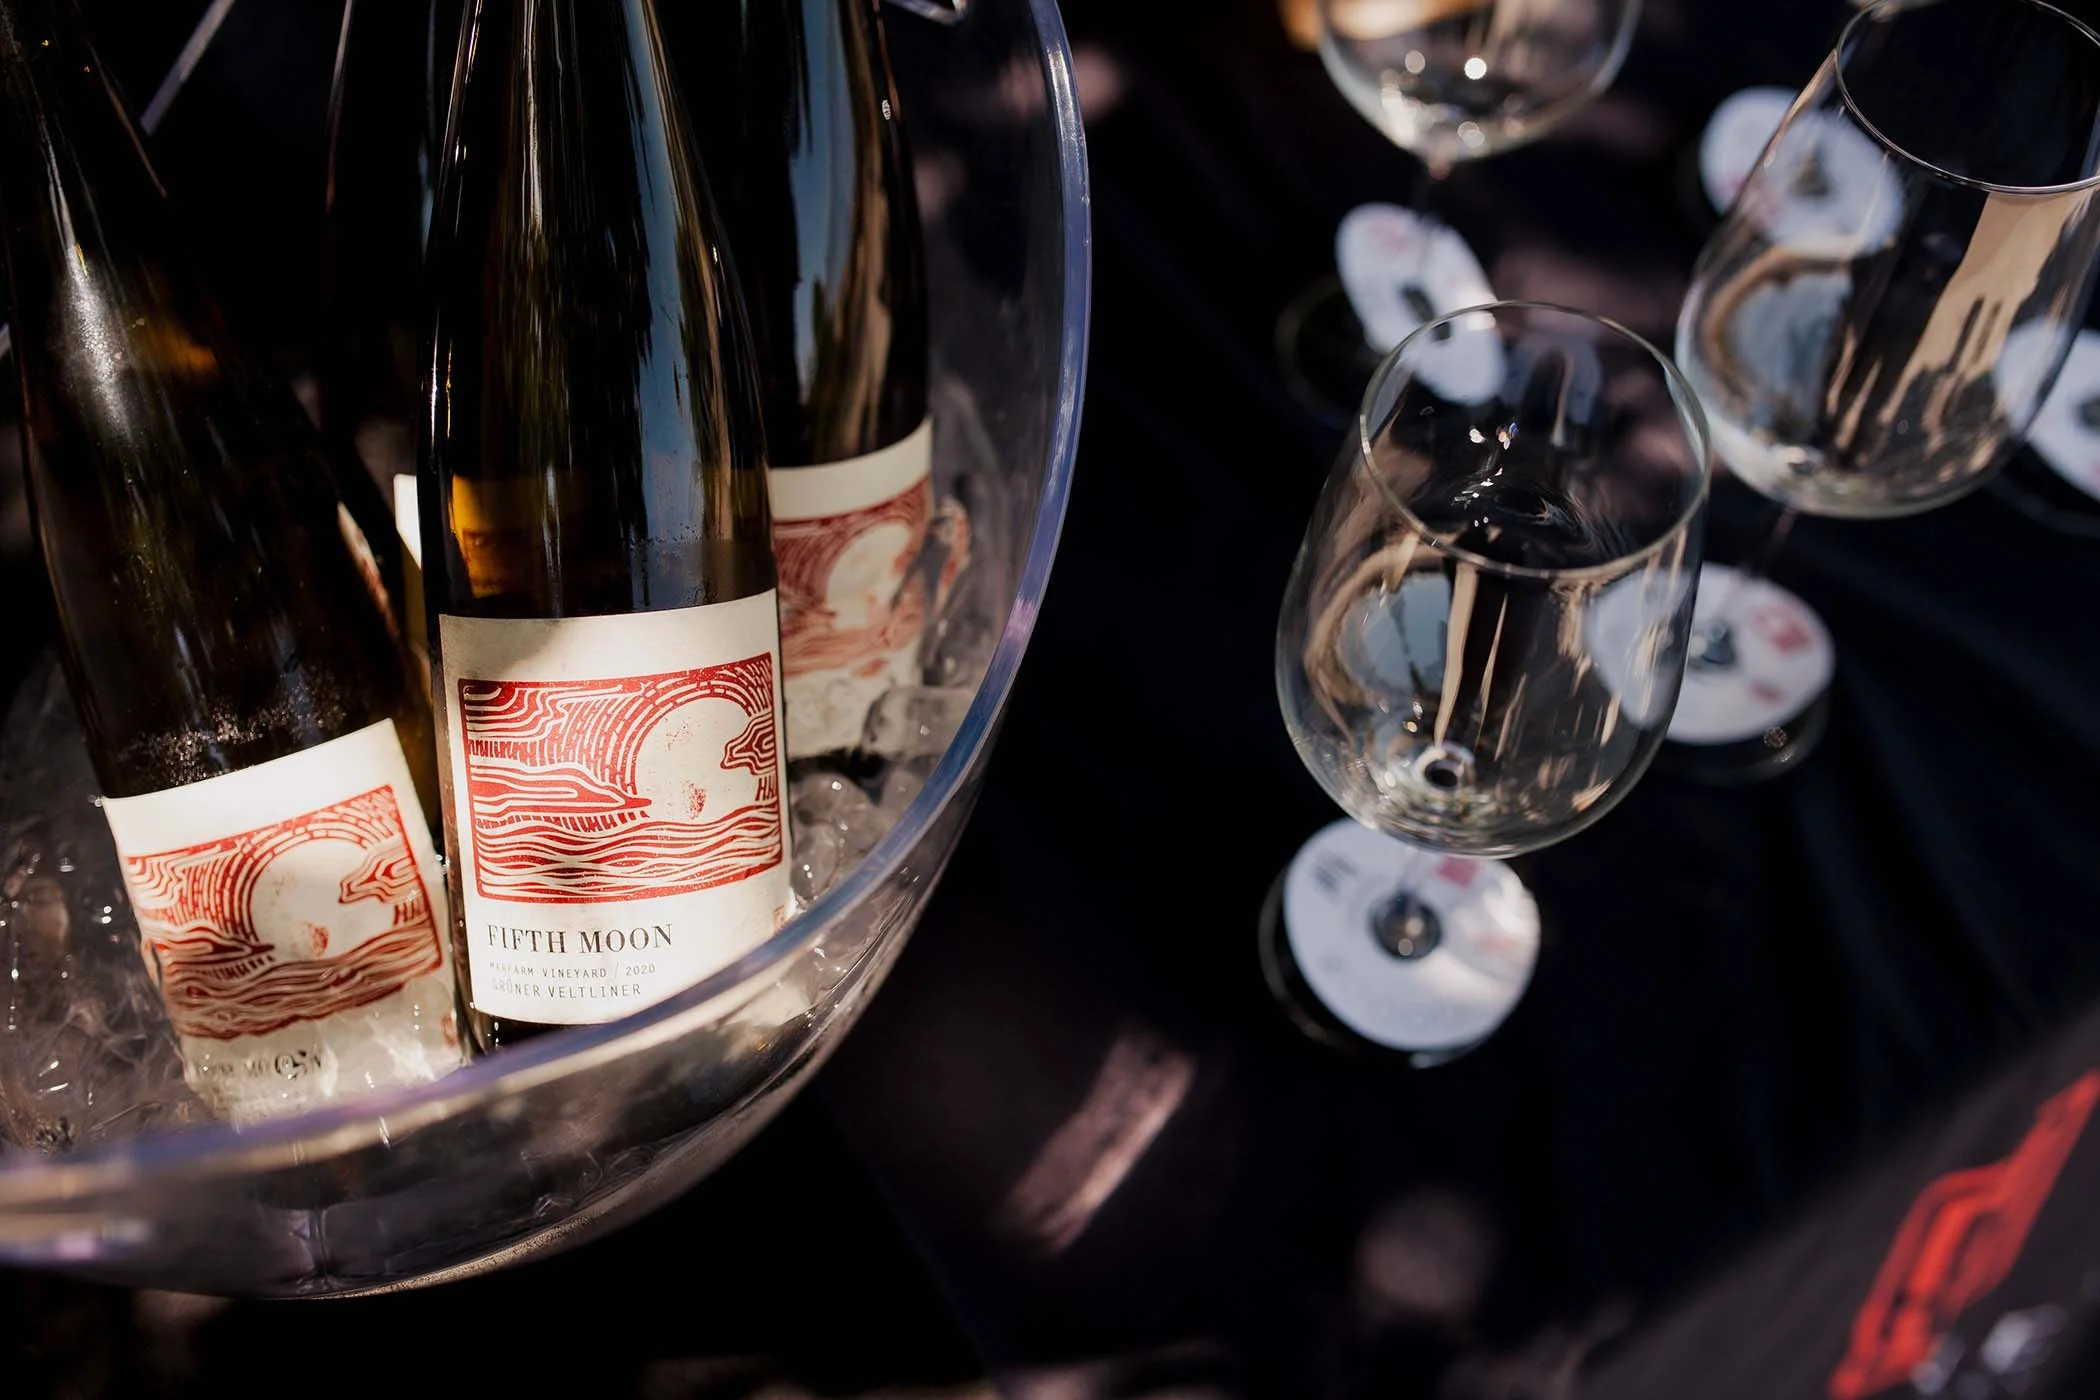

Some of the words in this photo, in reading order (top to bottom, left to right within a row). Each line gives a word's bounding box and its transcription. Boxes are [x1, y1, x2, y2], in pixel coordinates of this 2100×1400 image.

[488, 924, 567, 953] FIFTH
[578, 923, 673, 953] MOON
[542, 967, 607, 979] VINEYARD
[625, 963, 656, 977] 2020
[548, 983, 641, 999] VELTLINER
